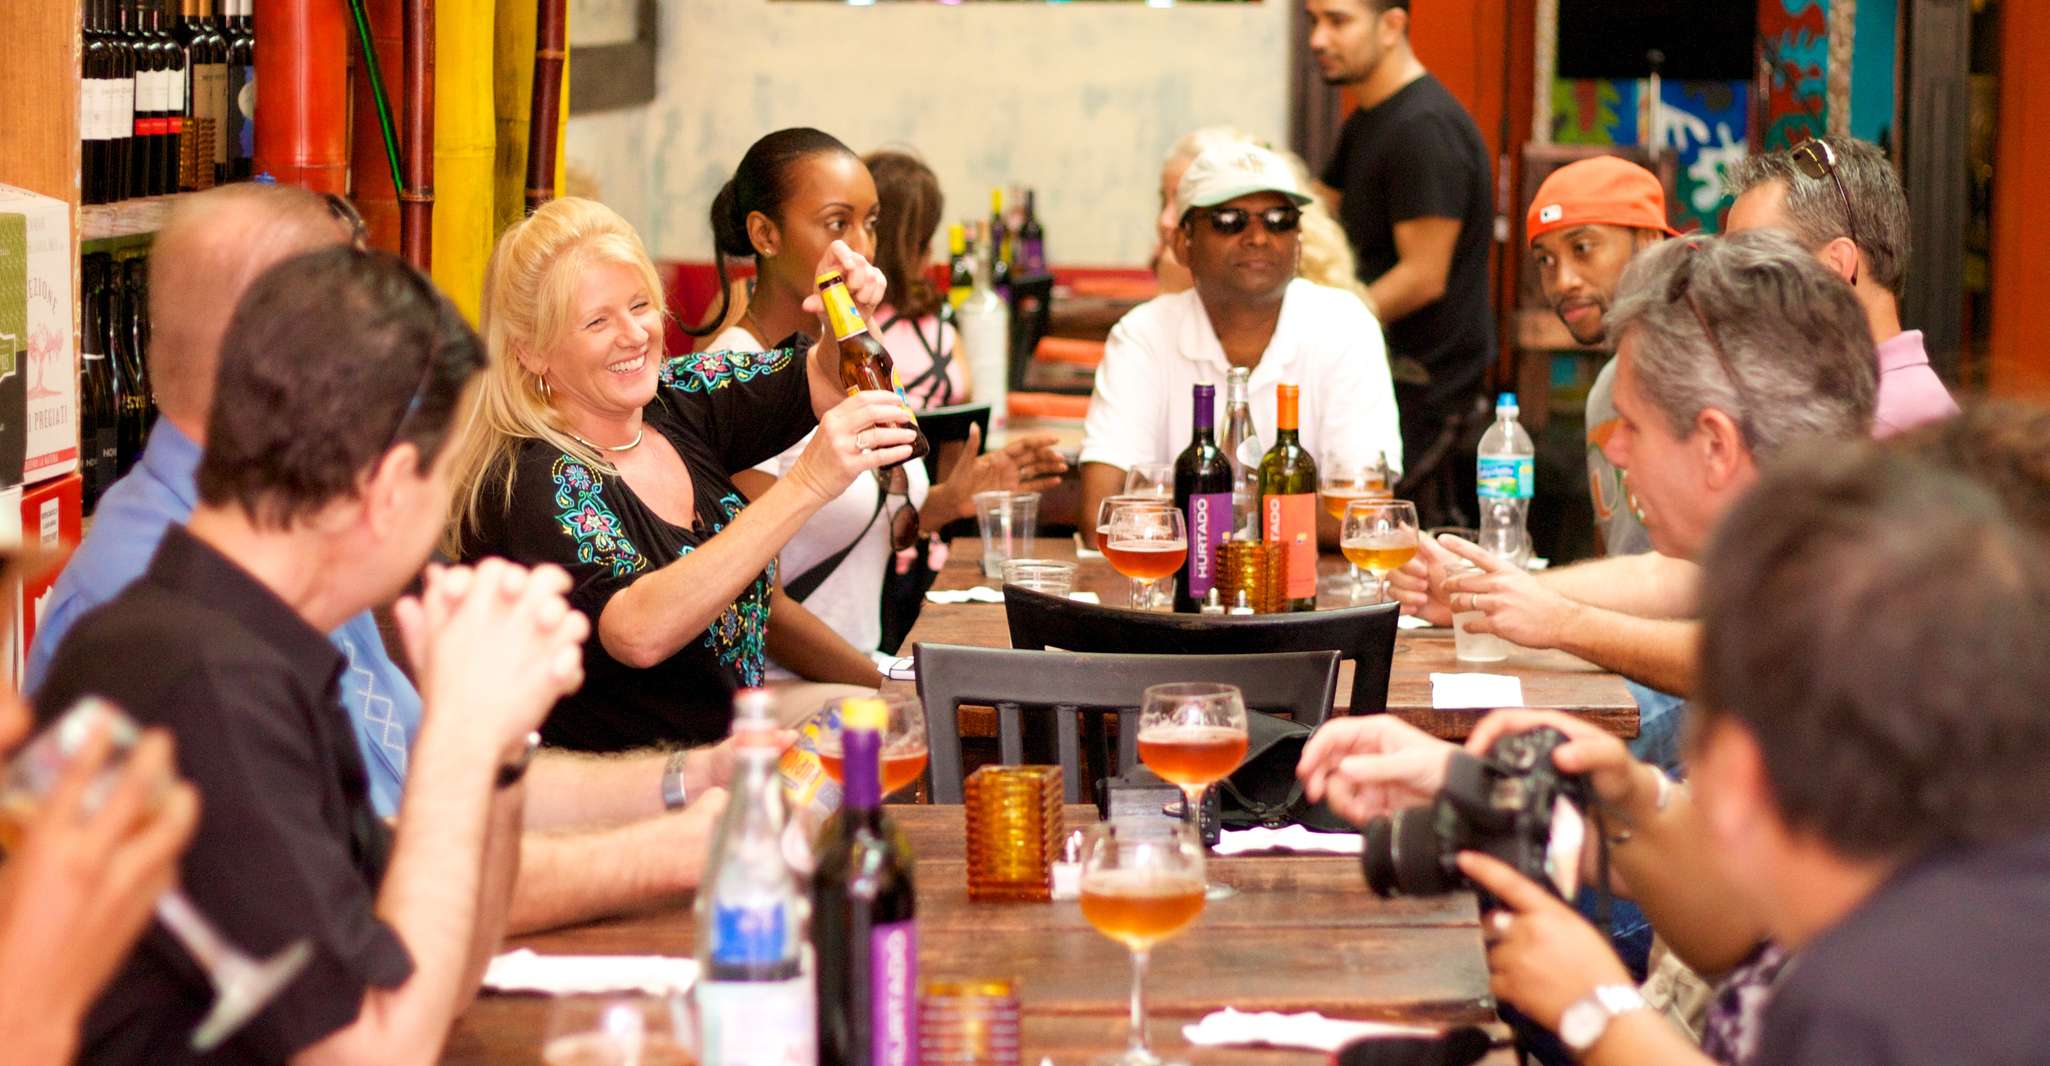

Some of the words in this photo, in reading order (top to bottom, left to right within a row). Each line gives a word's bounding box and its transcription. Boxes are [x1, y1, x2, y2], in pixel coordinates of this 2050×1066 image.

[28, 277, 58, 315] EZIONE
[1196, 497, 1208, 578] HURTADO
[1269, 498, 1280, 542] TADO
